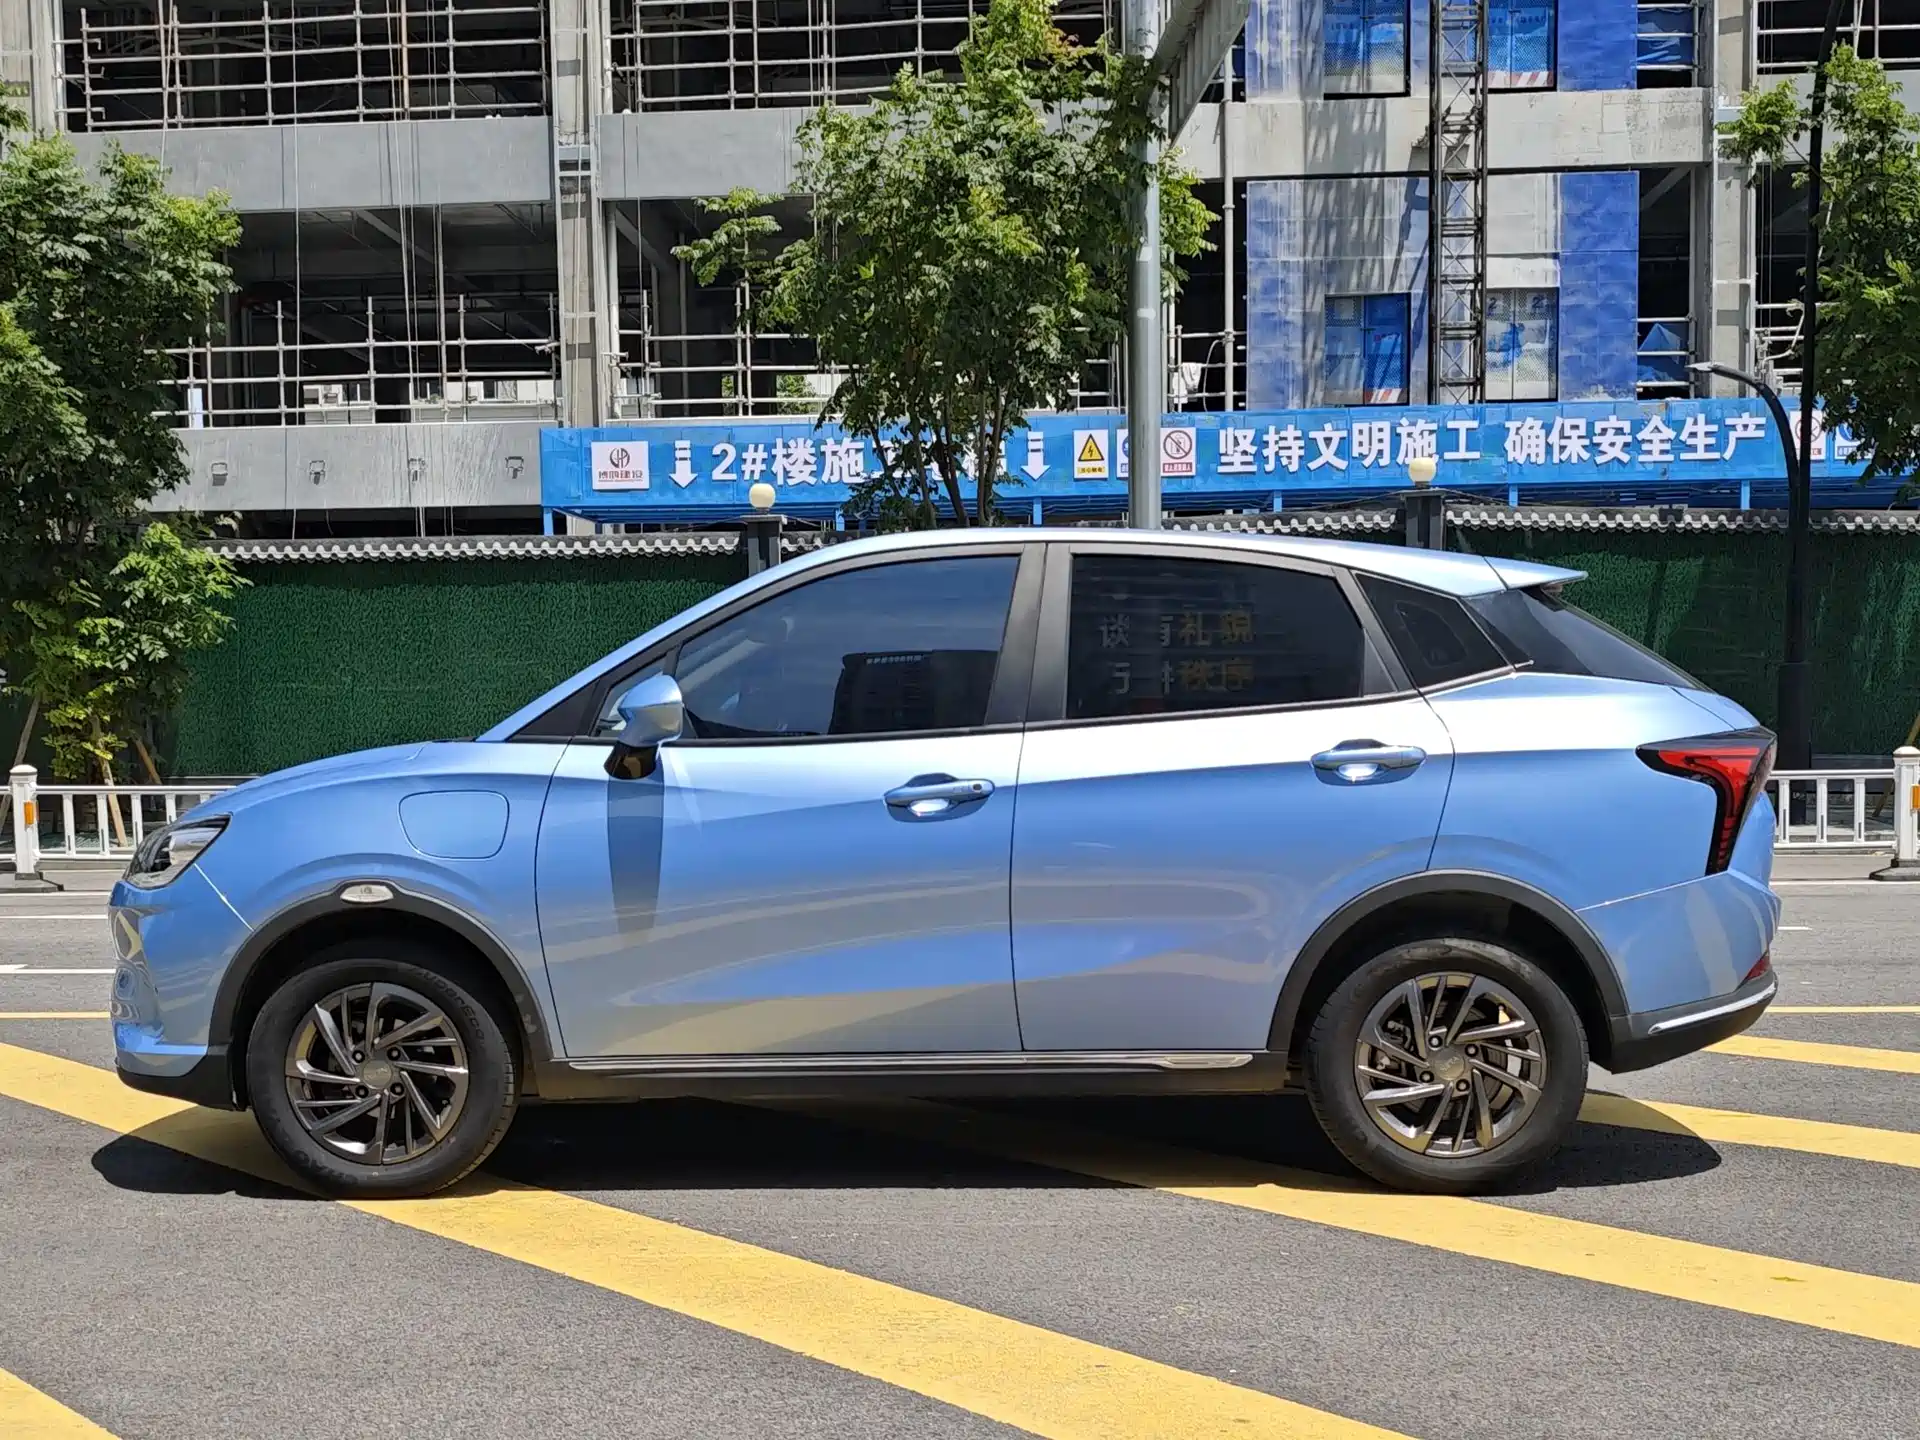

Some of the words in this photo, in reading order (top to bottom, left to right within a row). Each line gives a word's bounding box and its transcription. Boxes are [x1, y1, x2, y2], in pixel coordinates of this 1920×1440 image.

[712, 433, 1007, 486] 2#楼施工
[1217, 417, 1481, 474] 坚持文明施工
[1504, 412, 1767, 465] 确保安全生产
